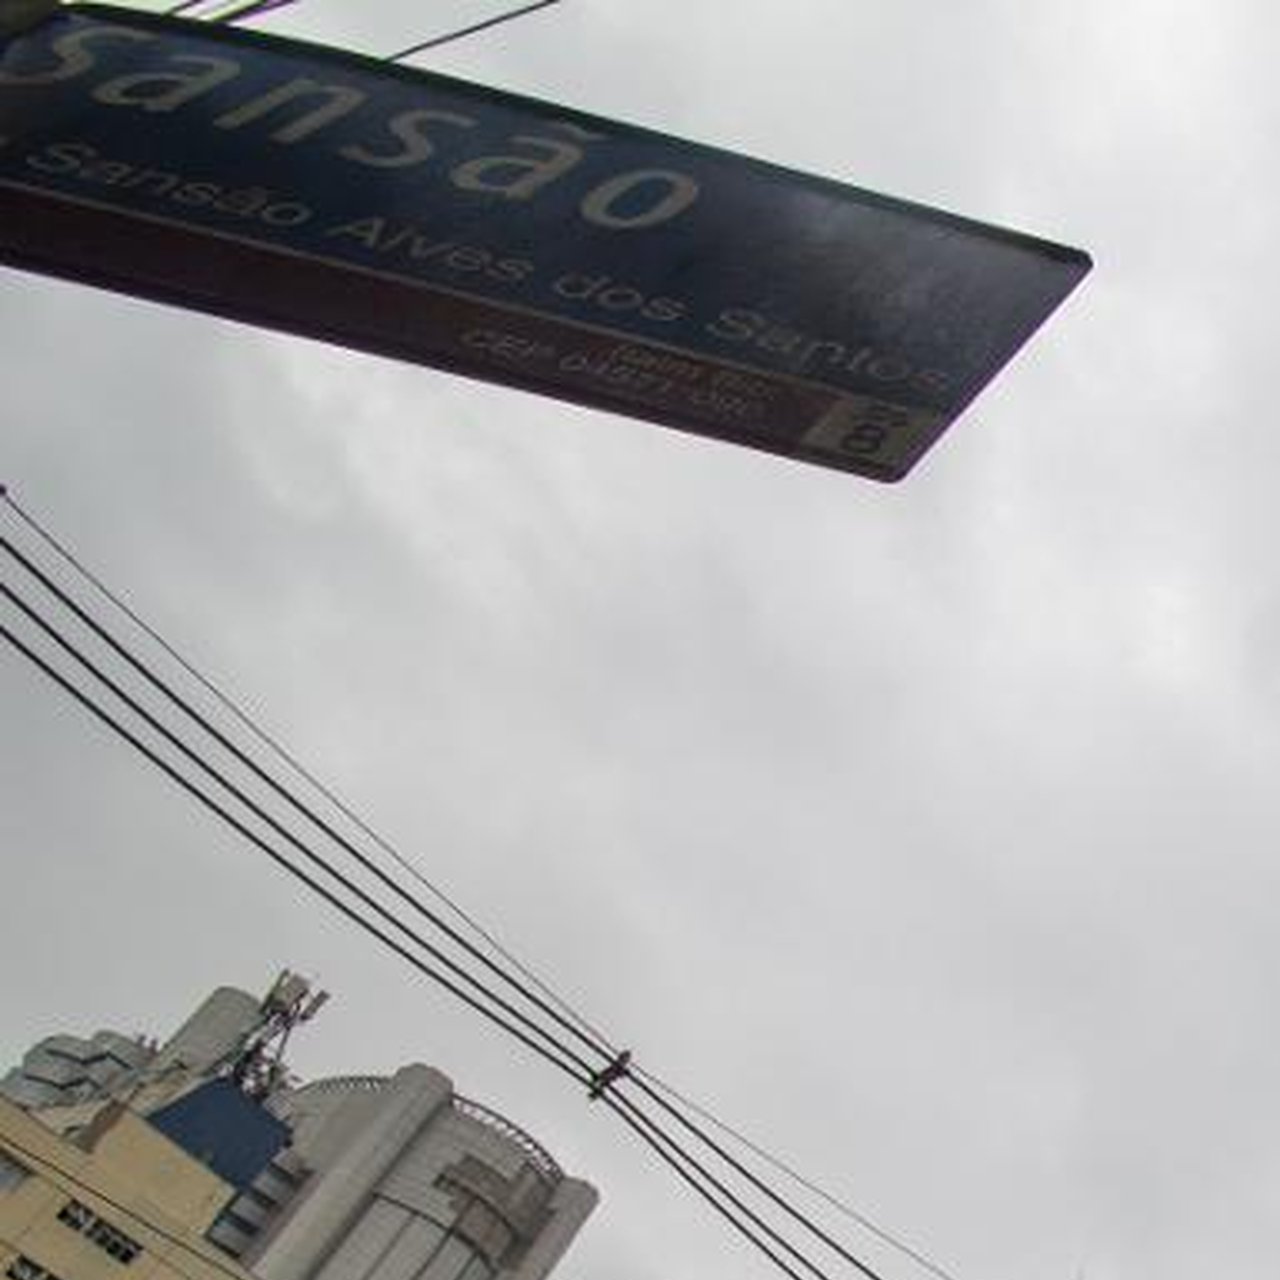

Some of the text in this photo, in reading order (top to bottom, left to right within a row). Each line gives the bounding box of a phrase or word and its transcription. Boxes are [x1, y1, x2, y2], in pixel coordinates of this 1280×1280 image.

[0, 25, 700, 229] Sansão
[25, 142, 312, 228] Sansão
[325, 215, 534, 283] Alves
[552, 267, 687, 322] dos
[704, 305, 950, 393] Santos
